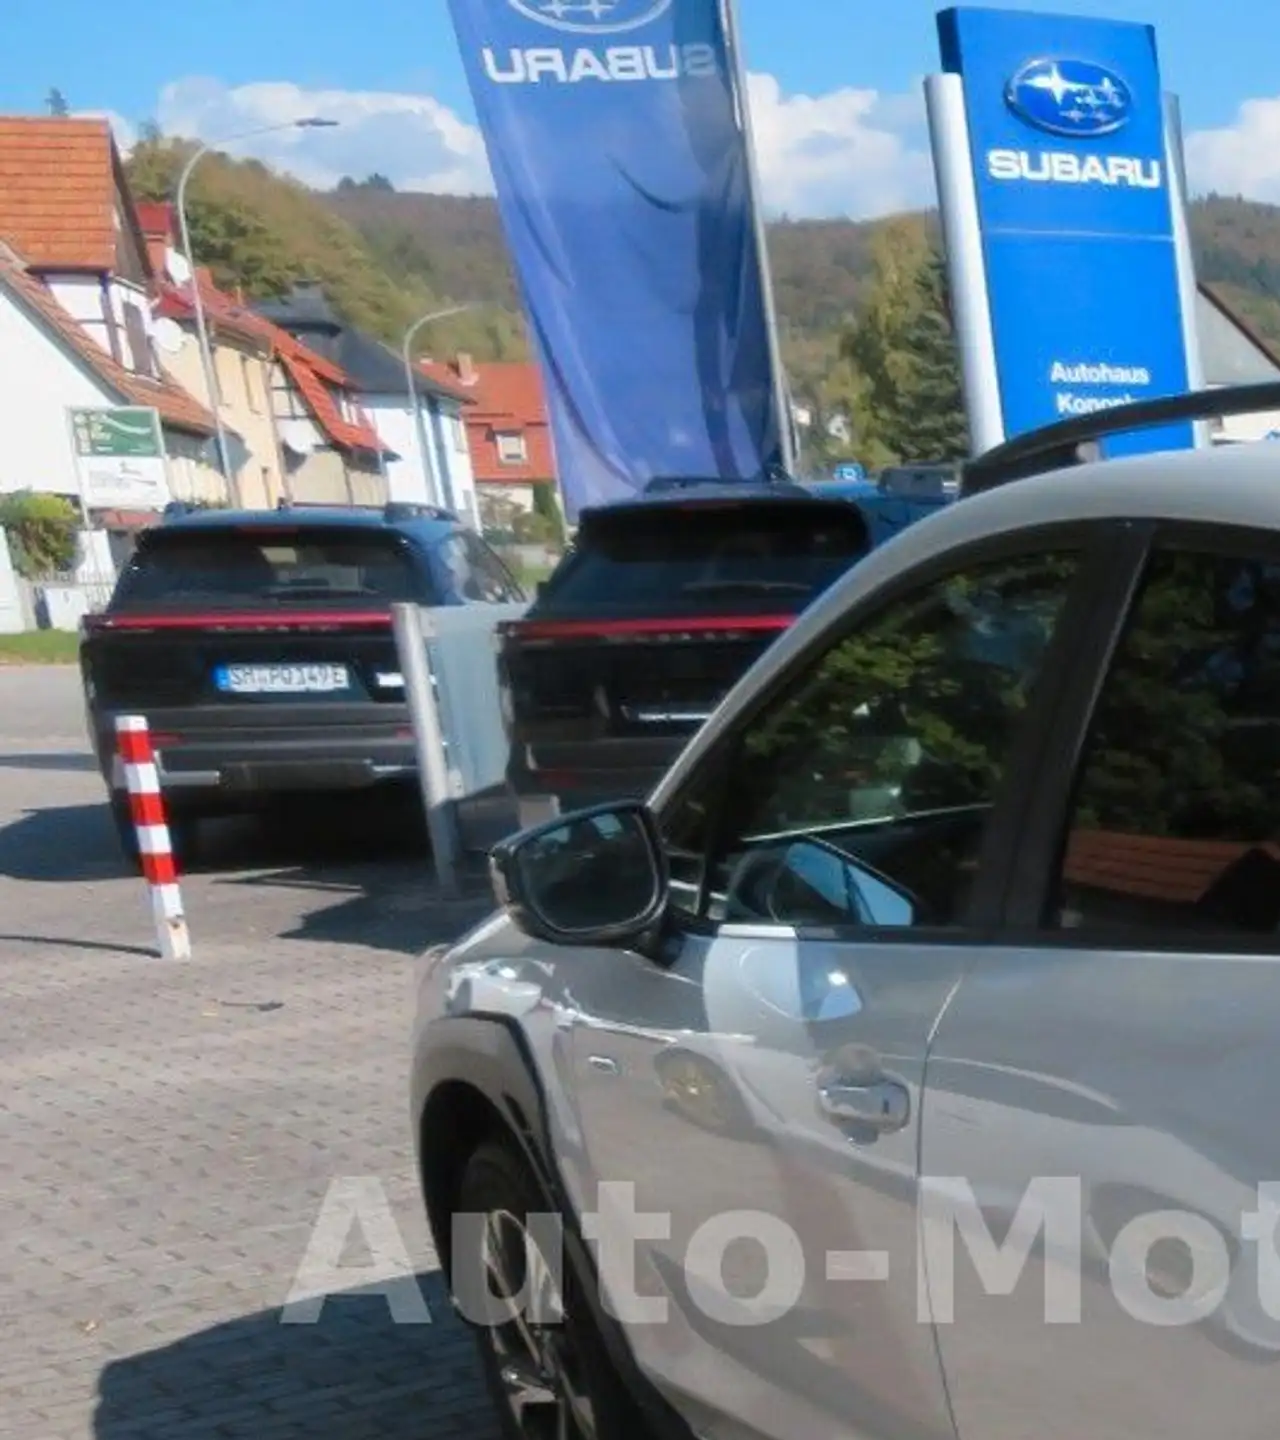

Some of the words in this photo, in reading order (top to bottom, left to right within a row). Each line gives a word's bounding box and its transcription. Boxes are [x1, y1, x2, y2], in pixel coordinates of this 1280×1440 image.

[988, 149, 1161, 189] SUBARU
[1050, 361, 1149, 385] Autohaus
[1056, 392, 1134, 415] Kono
